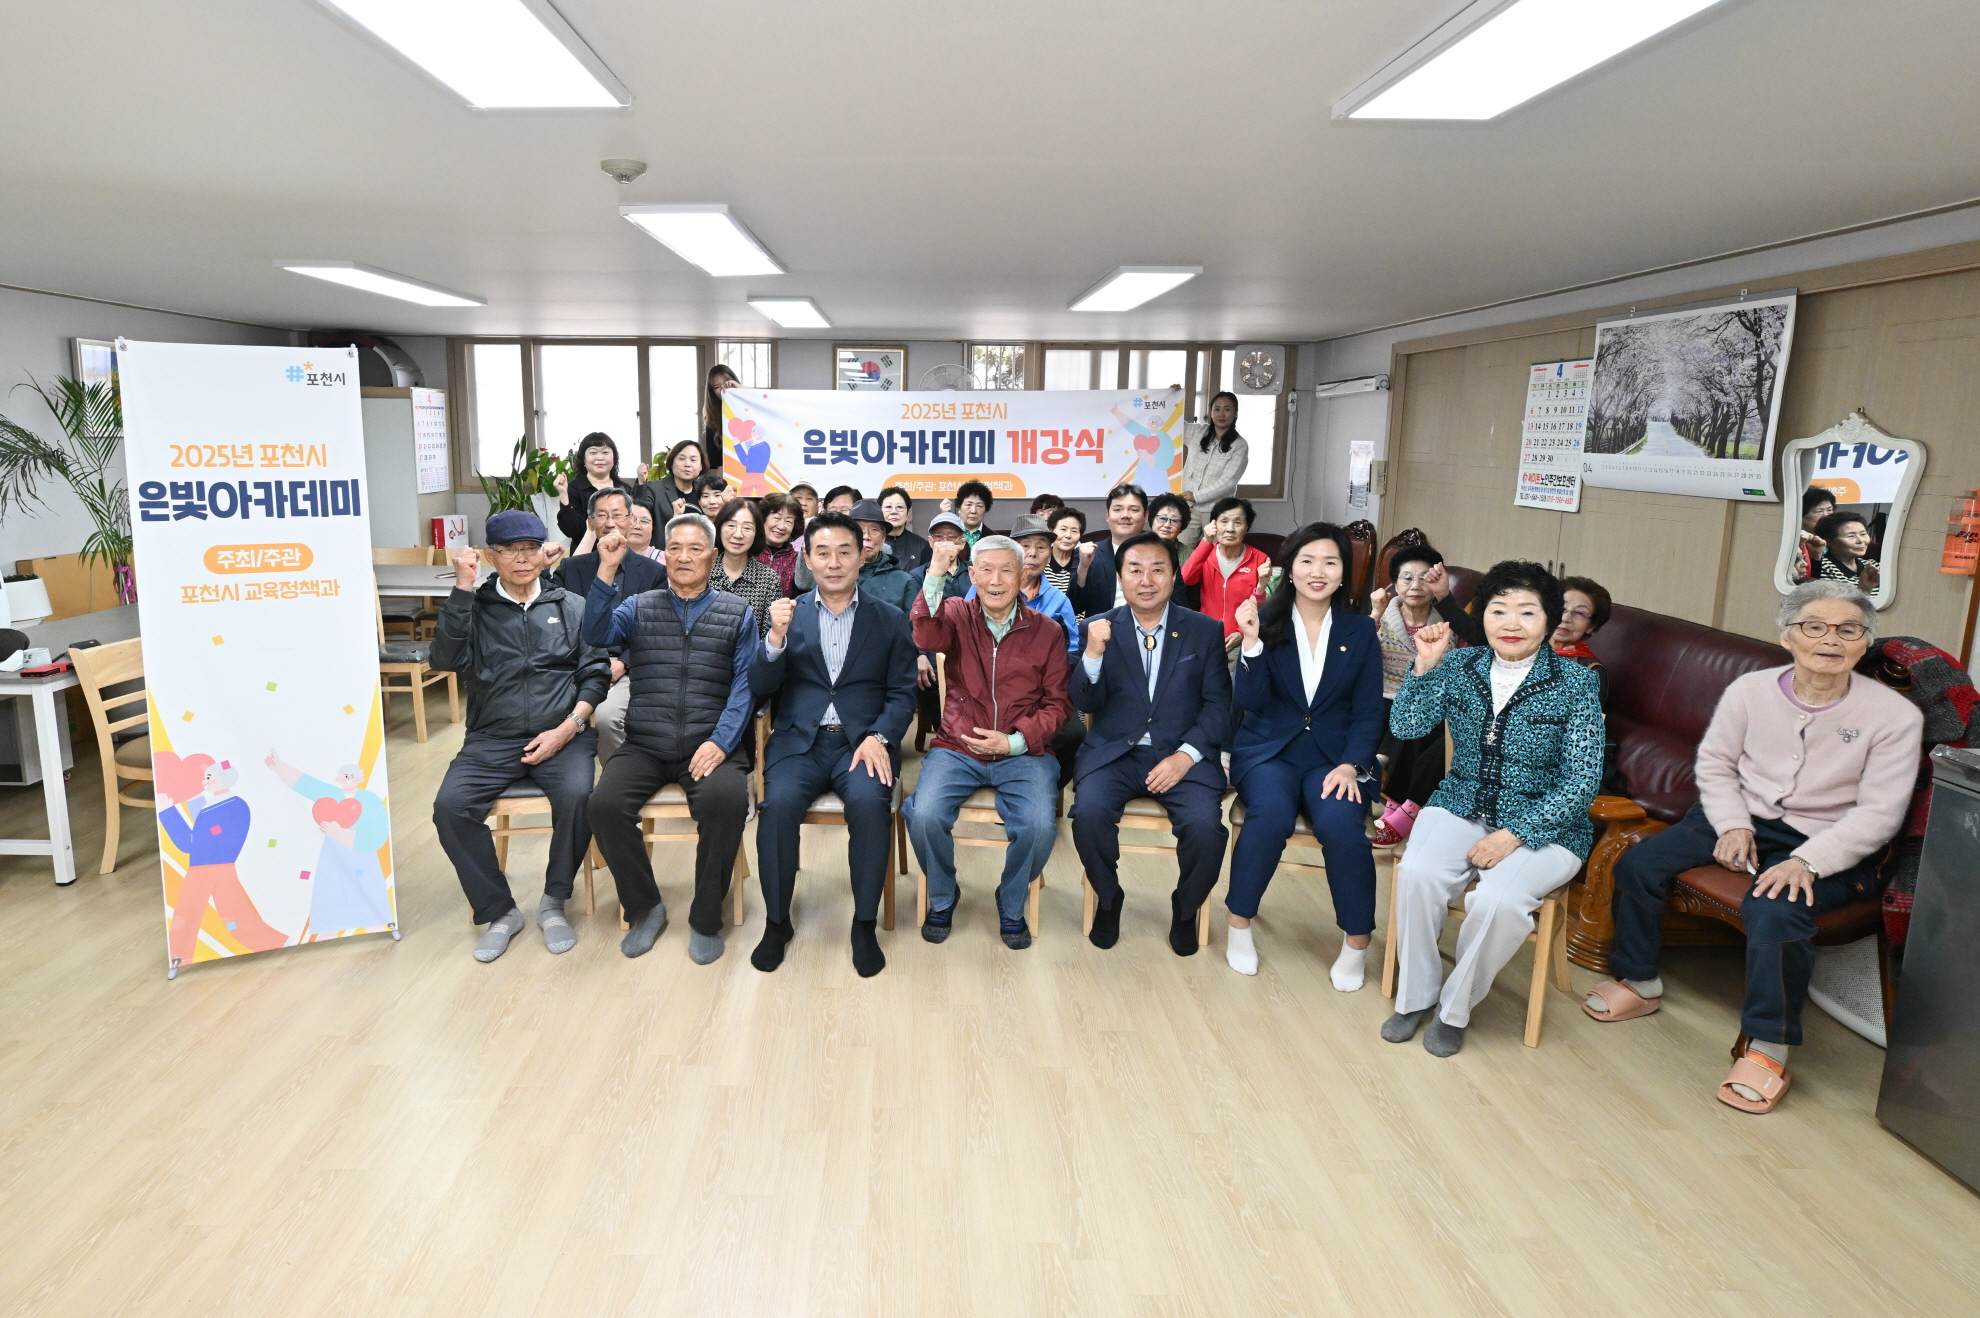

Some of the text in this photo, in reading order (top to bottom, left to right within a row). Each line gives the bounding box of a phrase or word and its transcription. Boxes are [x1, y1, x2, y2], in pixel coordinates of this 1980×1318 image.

[306, 372, 346, 387] 포천시
[1556, 363, 1564, 378] 4
[900, 402, 1008, 420] 2025년 포천시
[1144, 400, 1166, 410] 포천시
[169, 443, 328, 468] 2025년 포천시
[803, 428, 1104, 466] 은빛아카데미 개강식
[1583, 462, 1593, 473] 04
[138, 478, 361, 522] 은빛아카데미
[217, 548, 301, 569] 주최/주관
[181, 579, 340, 604] 포천시 교육정책과
